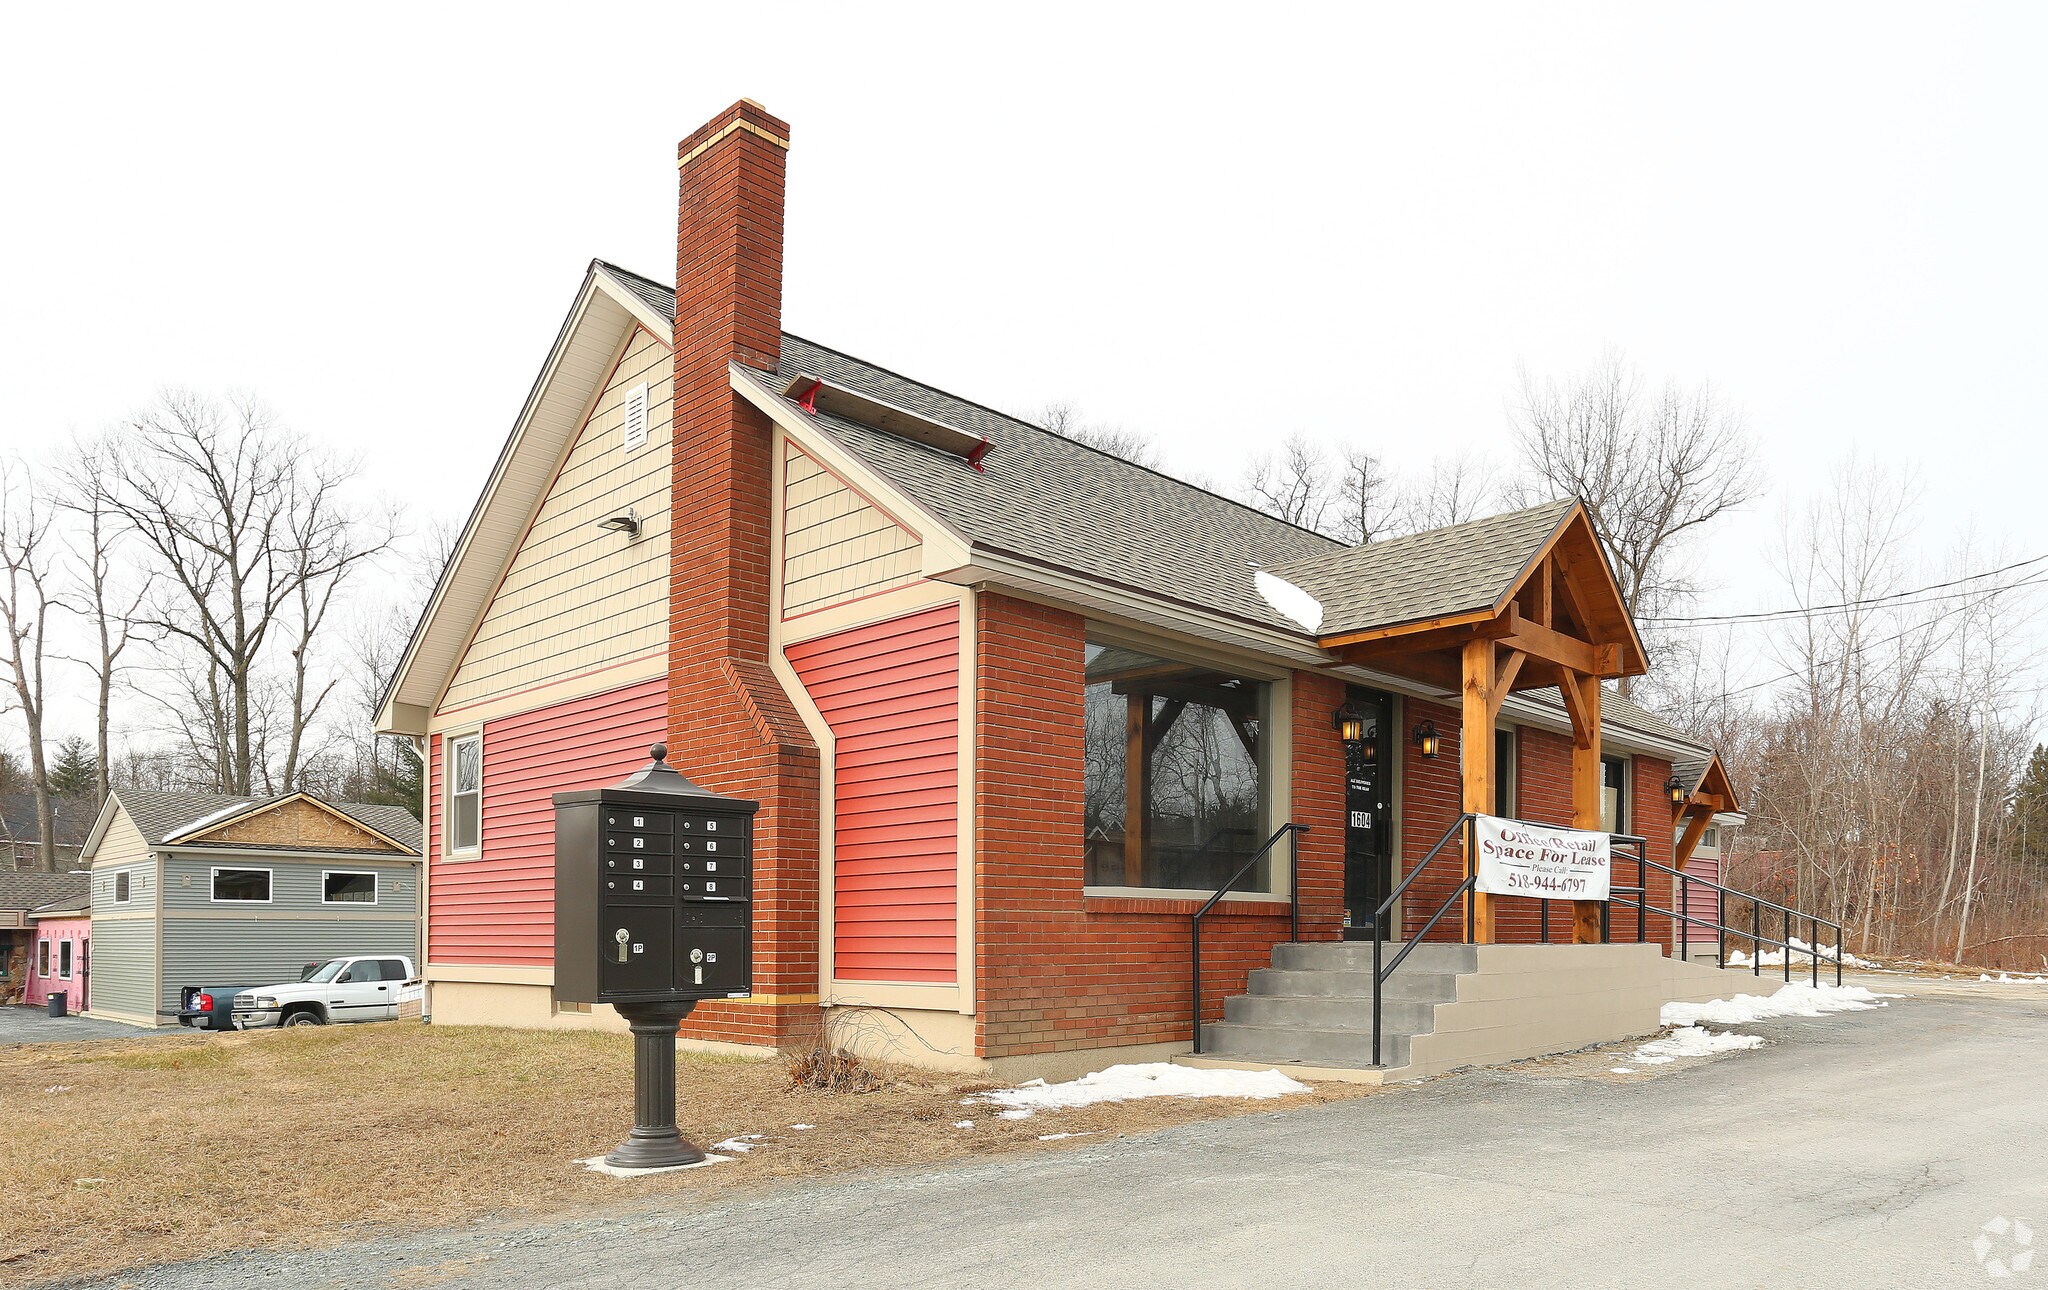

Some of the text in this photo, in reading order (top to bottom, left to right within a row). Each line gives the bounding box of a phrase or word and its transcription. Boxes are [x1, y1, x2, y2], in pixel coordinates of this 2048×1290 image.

[1352, 812, 1370, 828] 1604
[1483, 839, 1606, 867] Space For Lease
[1531, 863, 1553, 874] Please
[1508, 872, 1586, 893] 518-944-6797
[634, 944, 643, 952] 1P
[707, 953, 716, 962] 2P
